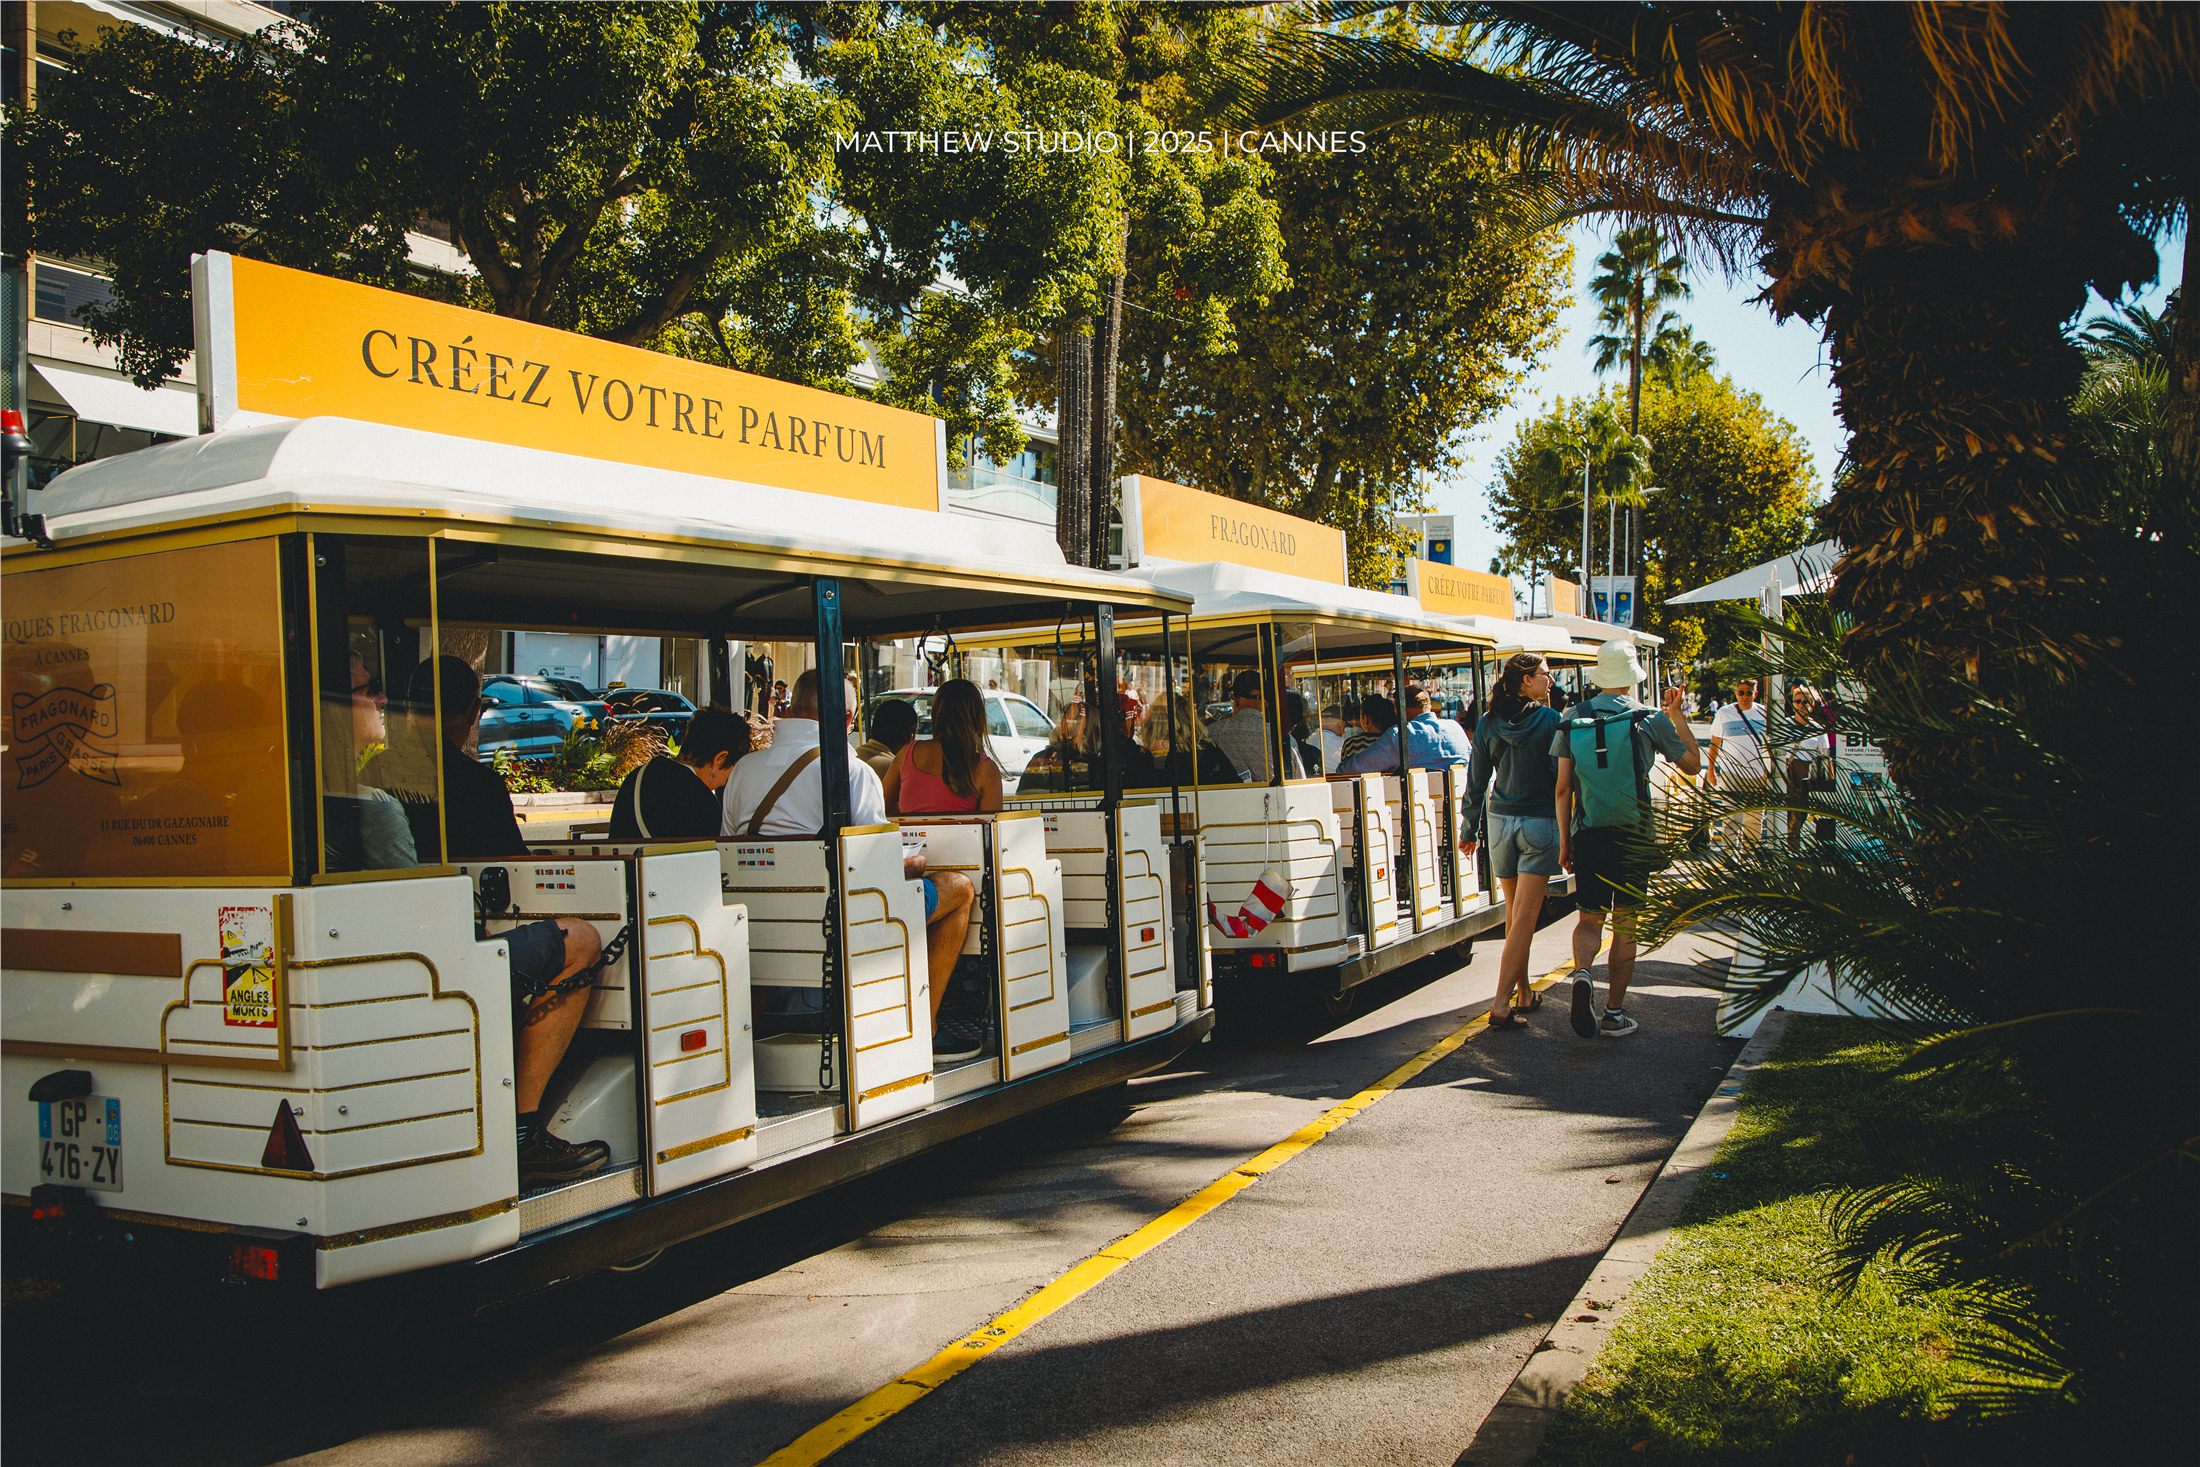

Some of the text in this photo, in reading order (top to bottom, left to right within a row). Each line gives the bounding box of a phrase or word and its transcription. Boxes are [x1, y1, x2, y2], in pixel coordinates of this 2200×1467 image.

[361, 329, 887, 469] CRÉEZ VOTRE PARFUM
[1210, 514, 1297, 556] FRAGONARD
[1428, 574, 1506, 606] CRÉEZ VOTRE PARFUM
[60, 602, 176, 636] FRAGONARD
[44, 648, 90, 665] CANNES
[21, 700, 110, 731] FRAGONARD
[26, 751, 57, 778] PARIS
[57, 732, 107, 774] GRASSE
[111, 819, 129, 831] RUE
[132, 819, 146, 830] DU
[148, 818, 162, 830] DR
[164, 816, 230, 829] GAZAGNAIRE
[133, 834, 197, 847] 06400 CANNES
[230, 990, 269, 1003] ANGLES
[107, 1124, 119, 1142] 06
